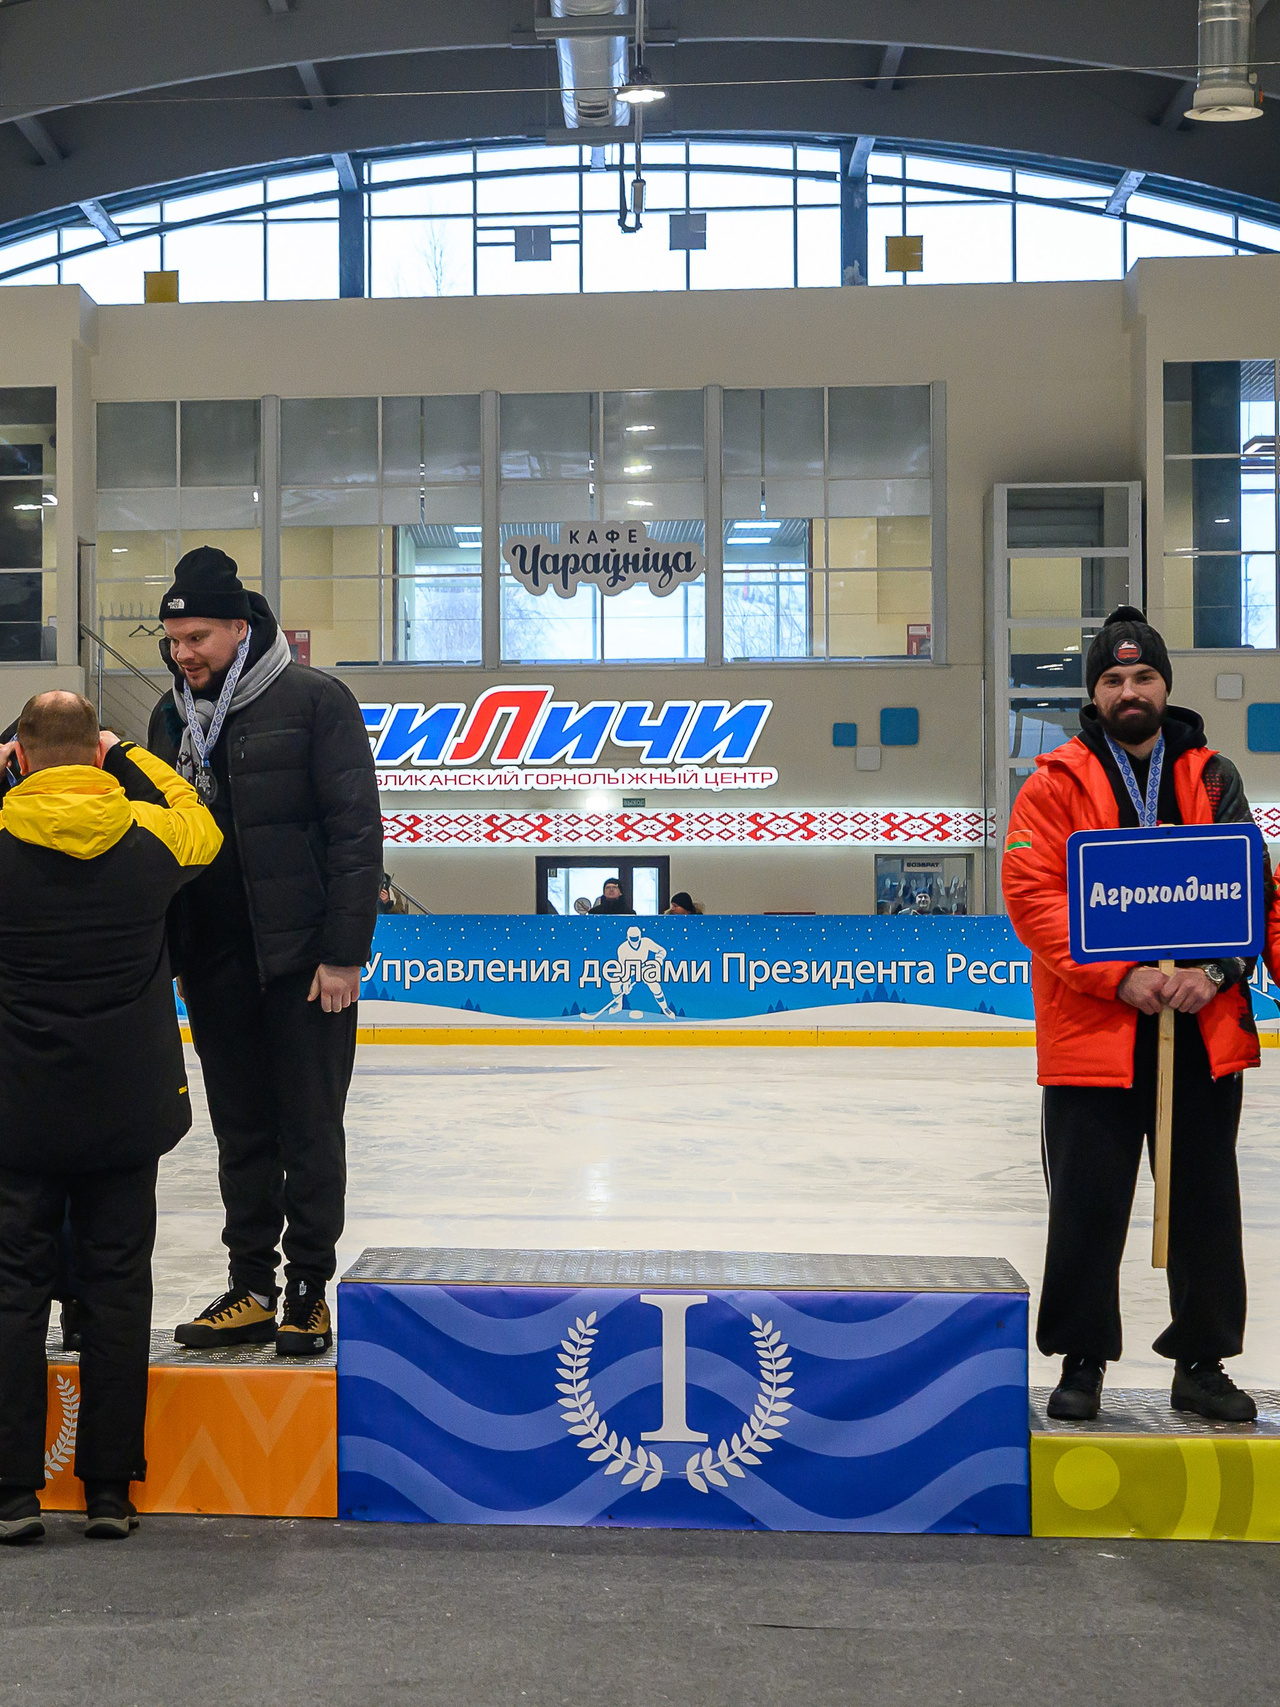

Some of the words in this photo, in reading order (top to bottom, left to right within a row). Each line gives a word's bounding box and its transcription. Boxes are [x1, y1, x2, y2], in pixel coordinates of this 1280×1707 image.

[569, 529, 638, 544] КАФЕ
[511, 547, 697, 590] Чараўніца
[524, 769, 699, 786] ГОРНОЛЫЖНЫЙ
[704, 771, 773, 787] ЦЕНТР
[1089, 875, 1243, 913] Агрохолдинг
[361, 952, 570, 990] Управления
[579, 958, 712, 989] делами
[722, 952, 935, 991] Президента
[946, 953, 1032, 992] Респ
